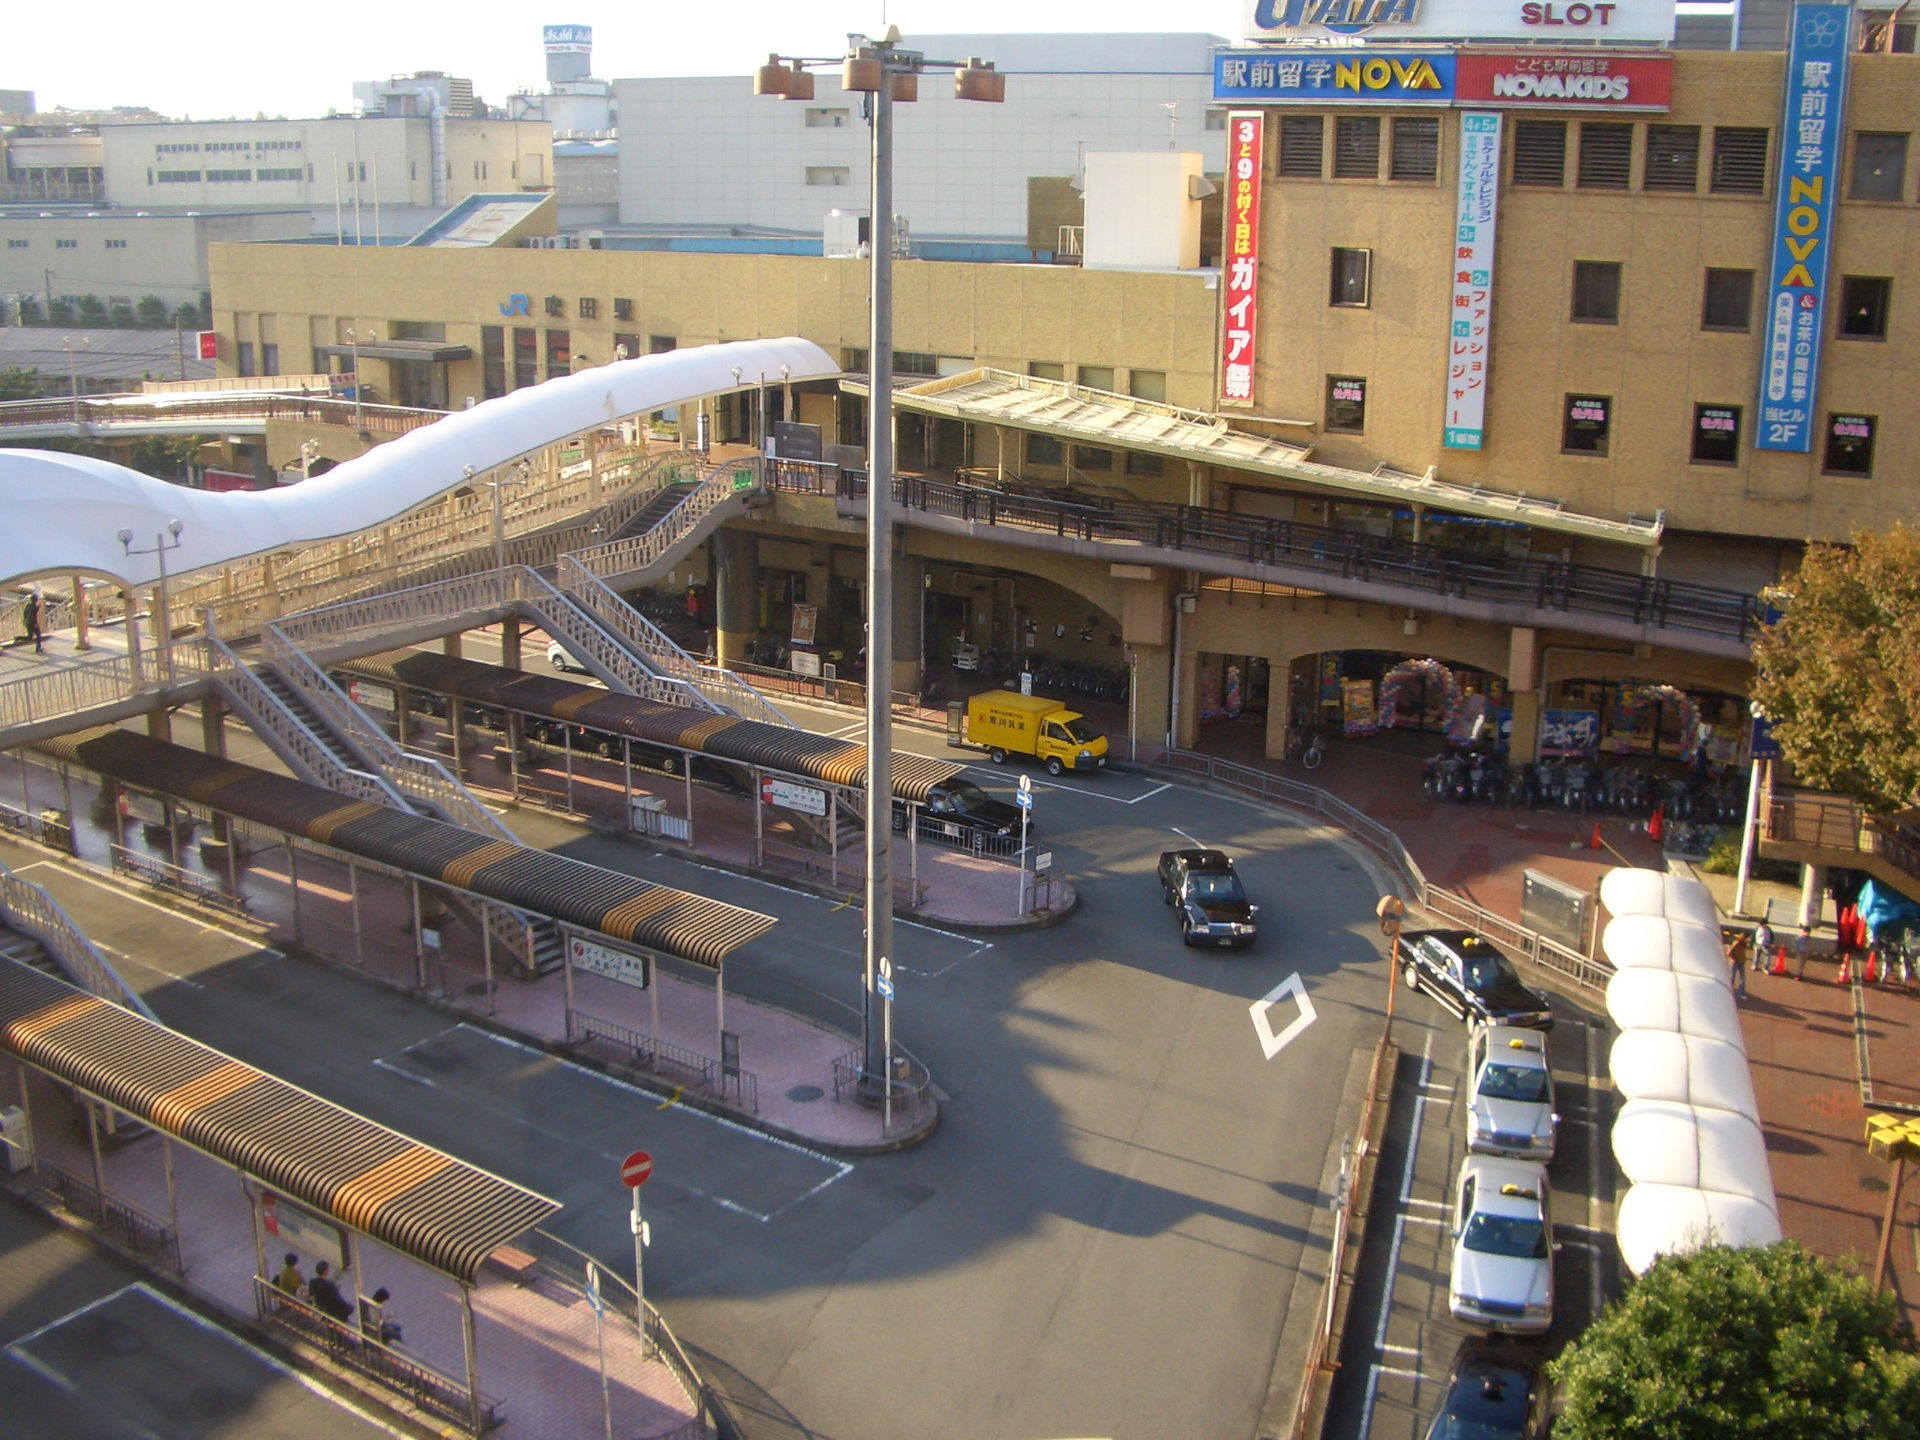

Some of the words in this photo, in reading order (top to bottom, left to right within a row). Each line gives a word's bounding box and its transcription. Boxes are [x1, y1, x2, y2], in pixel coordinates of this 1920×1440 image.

[1521, 2, 1617, 25] SLOT
[1222, 59, 1331, 90] 駅前留学
[1335, 58, 1441, 93] NOVA
[1513, 58, 1610, 73] こども駅前留学
[1795, 61, 1832, 173] 駅前留学
[1780, 176, 1824, 288] NOVA
[499, 294, 529, 317] JR
[1768, 424, 1799, 443] 2F
